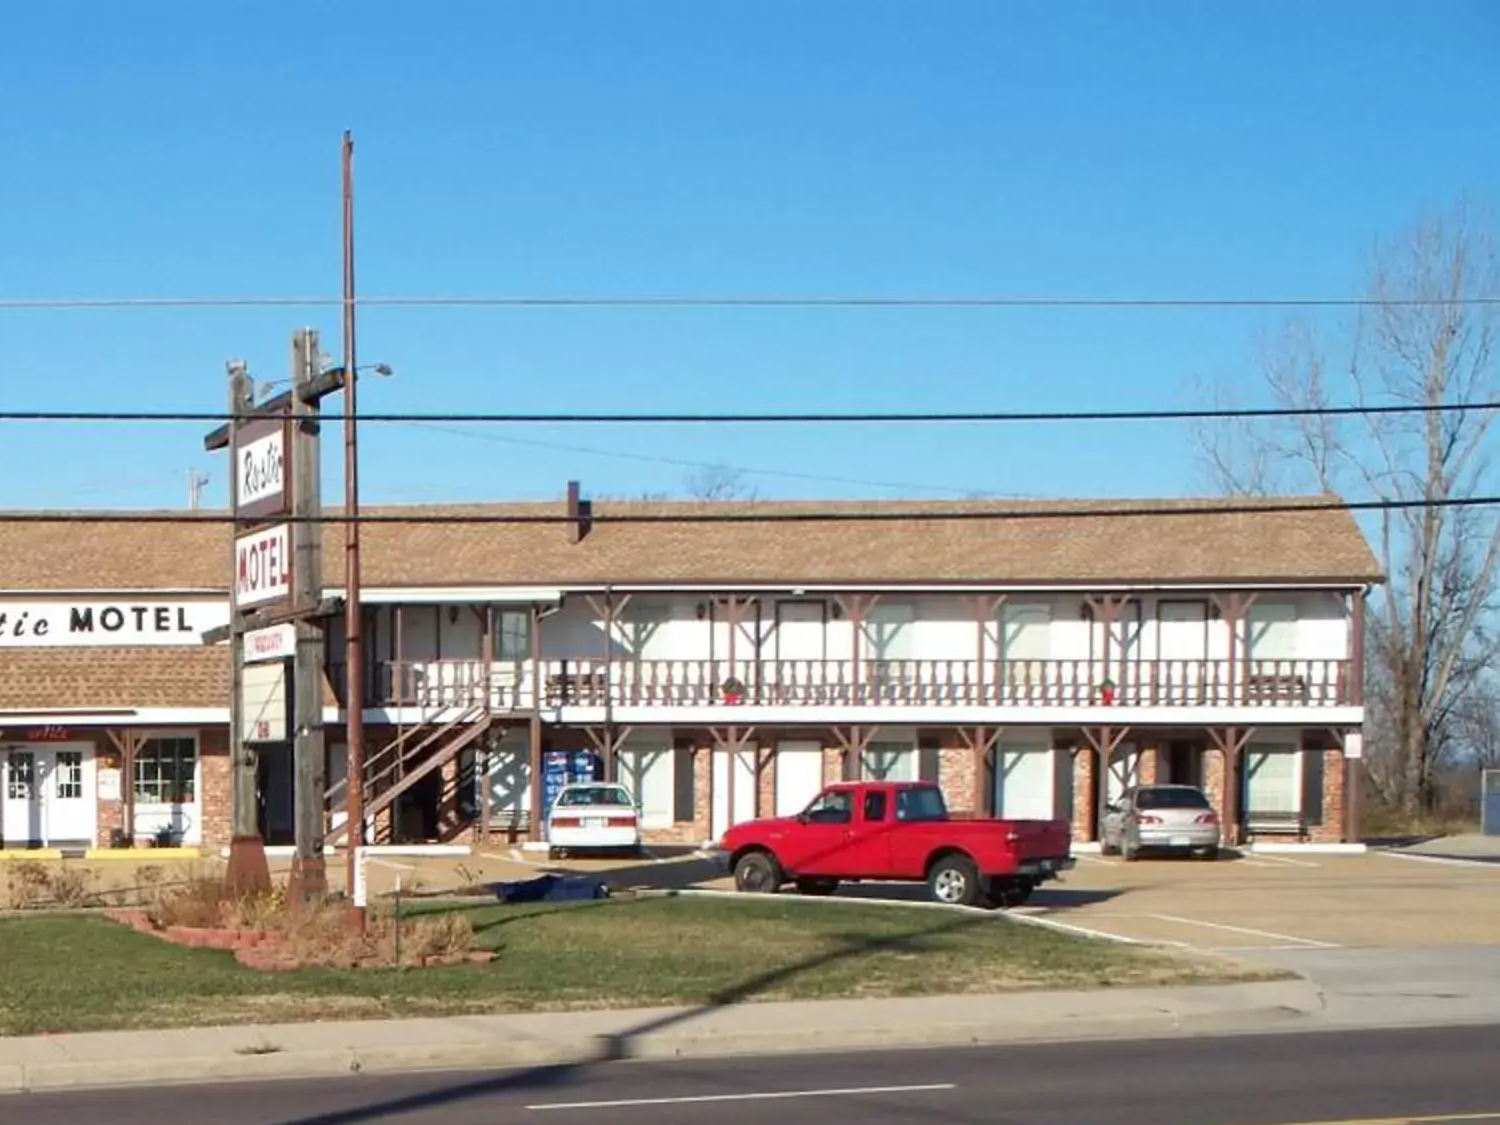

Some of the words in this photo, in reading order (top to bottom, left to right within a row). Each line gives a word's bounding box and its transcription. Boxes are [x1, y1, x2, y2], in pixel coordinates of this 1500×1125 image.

[243, 440, 283, 496] Rustic
[237, 535, 292, 595] MOTEL
[69, 606, 193, 632] MOTEL
